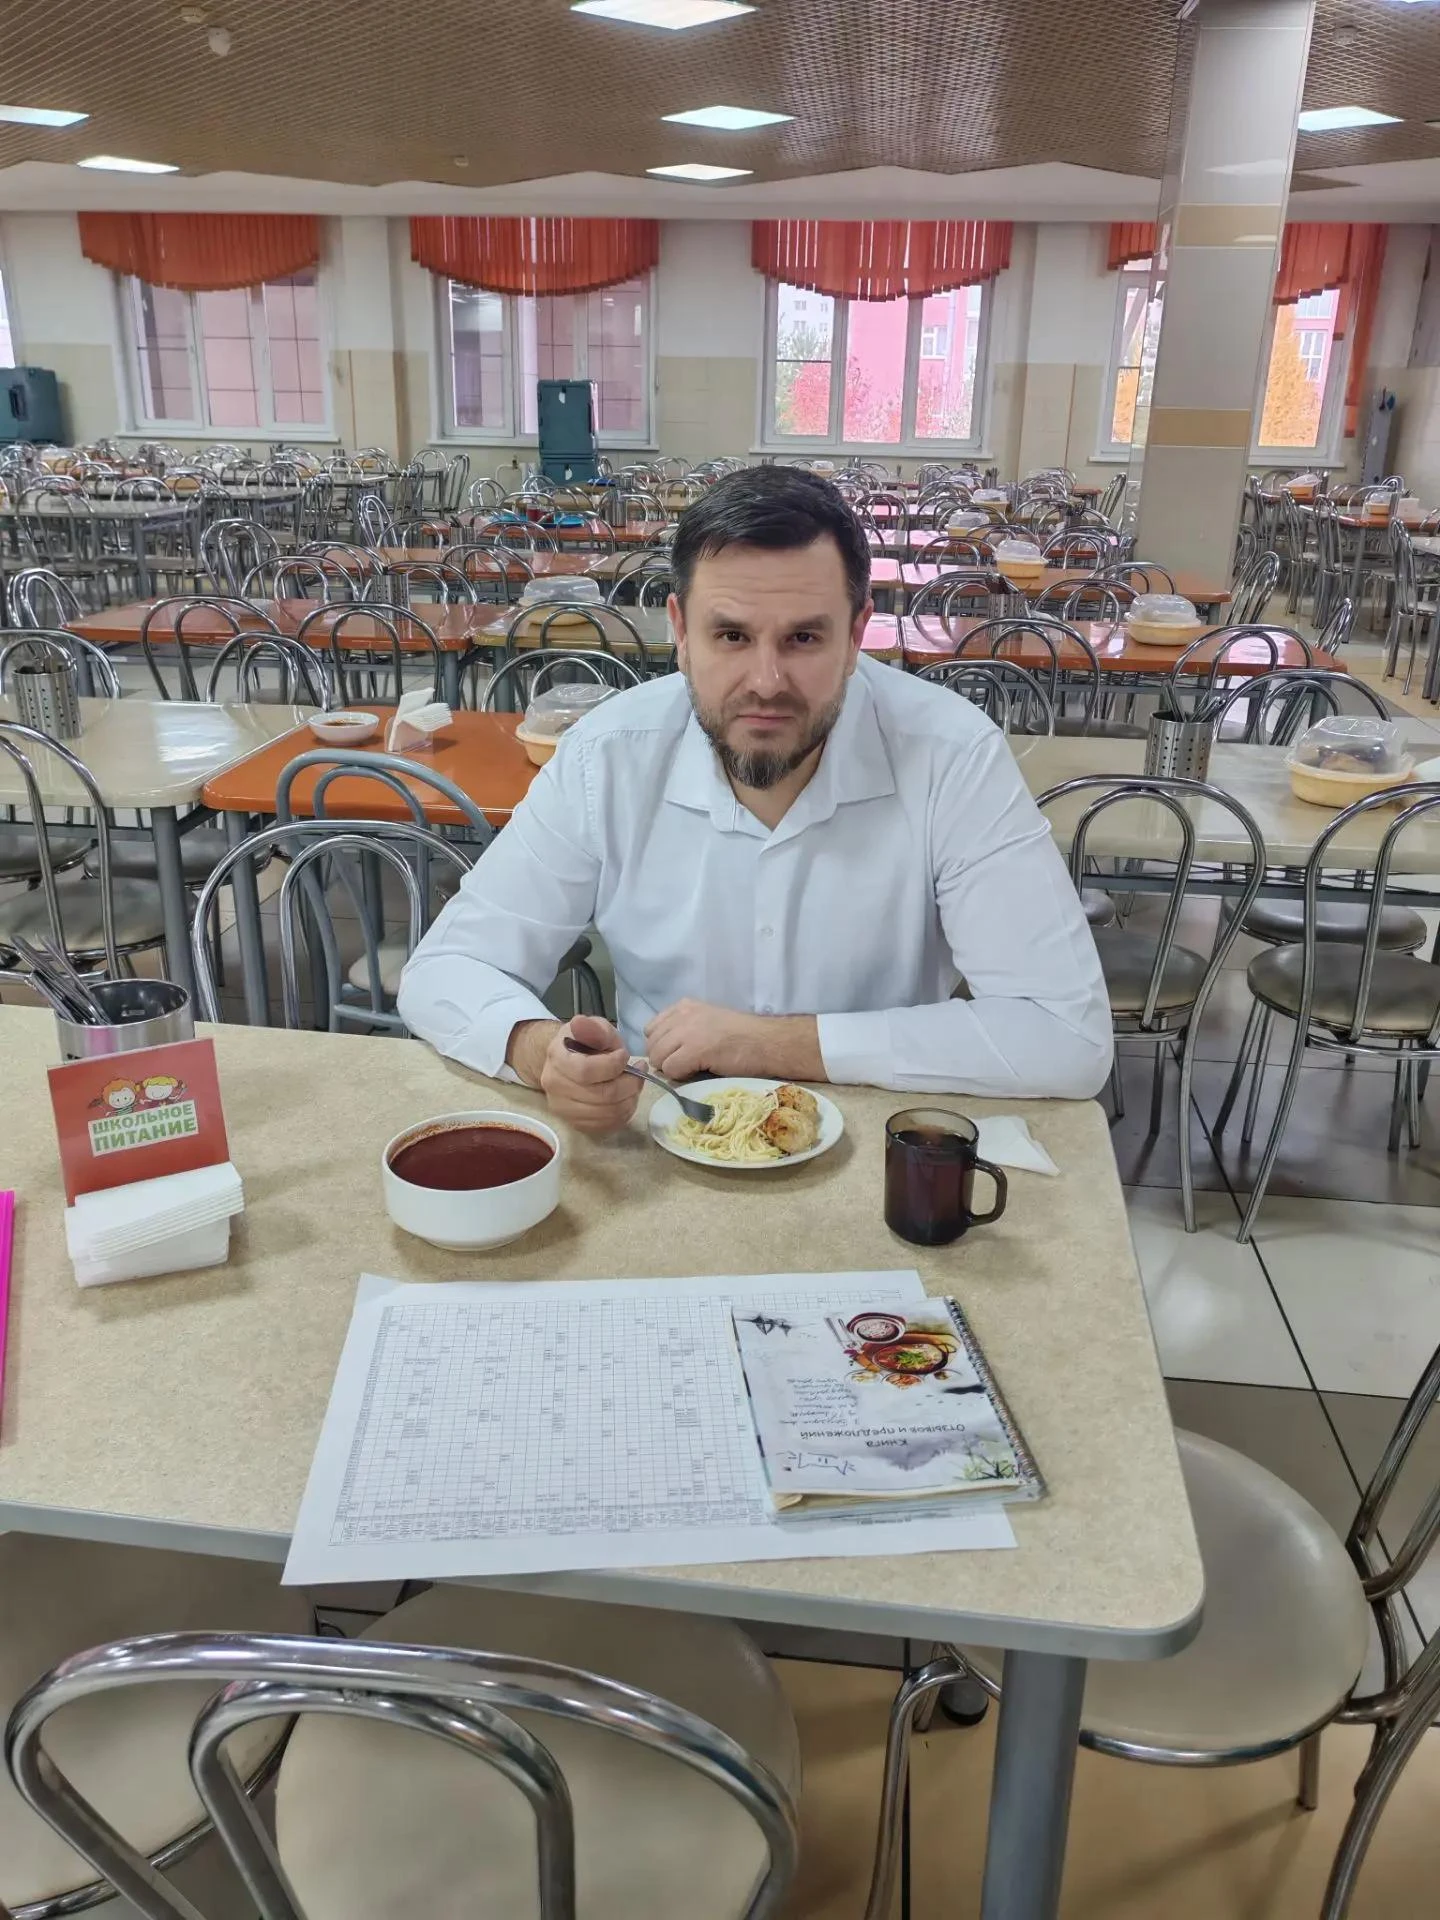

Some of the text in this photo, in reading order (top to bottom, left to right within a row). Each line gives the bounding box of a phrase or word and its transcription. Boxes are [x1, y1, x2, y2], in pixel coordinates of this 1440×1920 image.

[93, 1104, 193, 1134] ШКОЛЬНОЕ
[95, 1118, 197, 1151] ПИТАНИЕ
[800, 1427, 896, 1440] предложений
[909, 1424, 967, 1434] Отзывов
[865, 1438, 909, 1448] Книга
